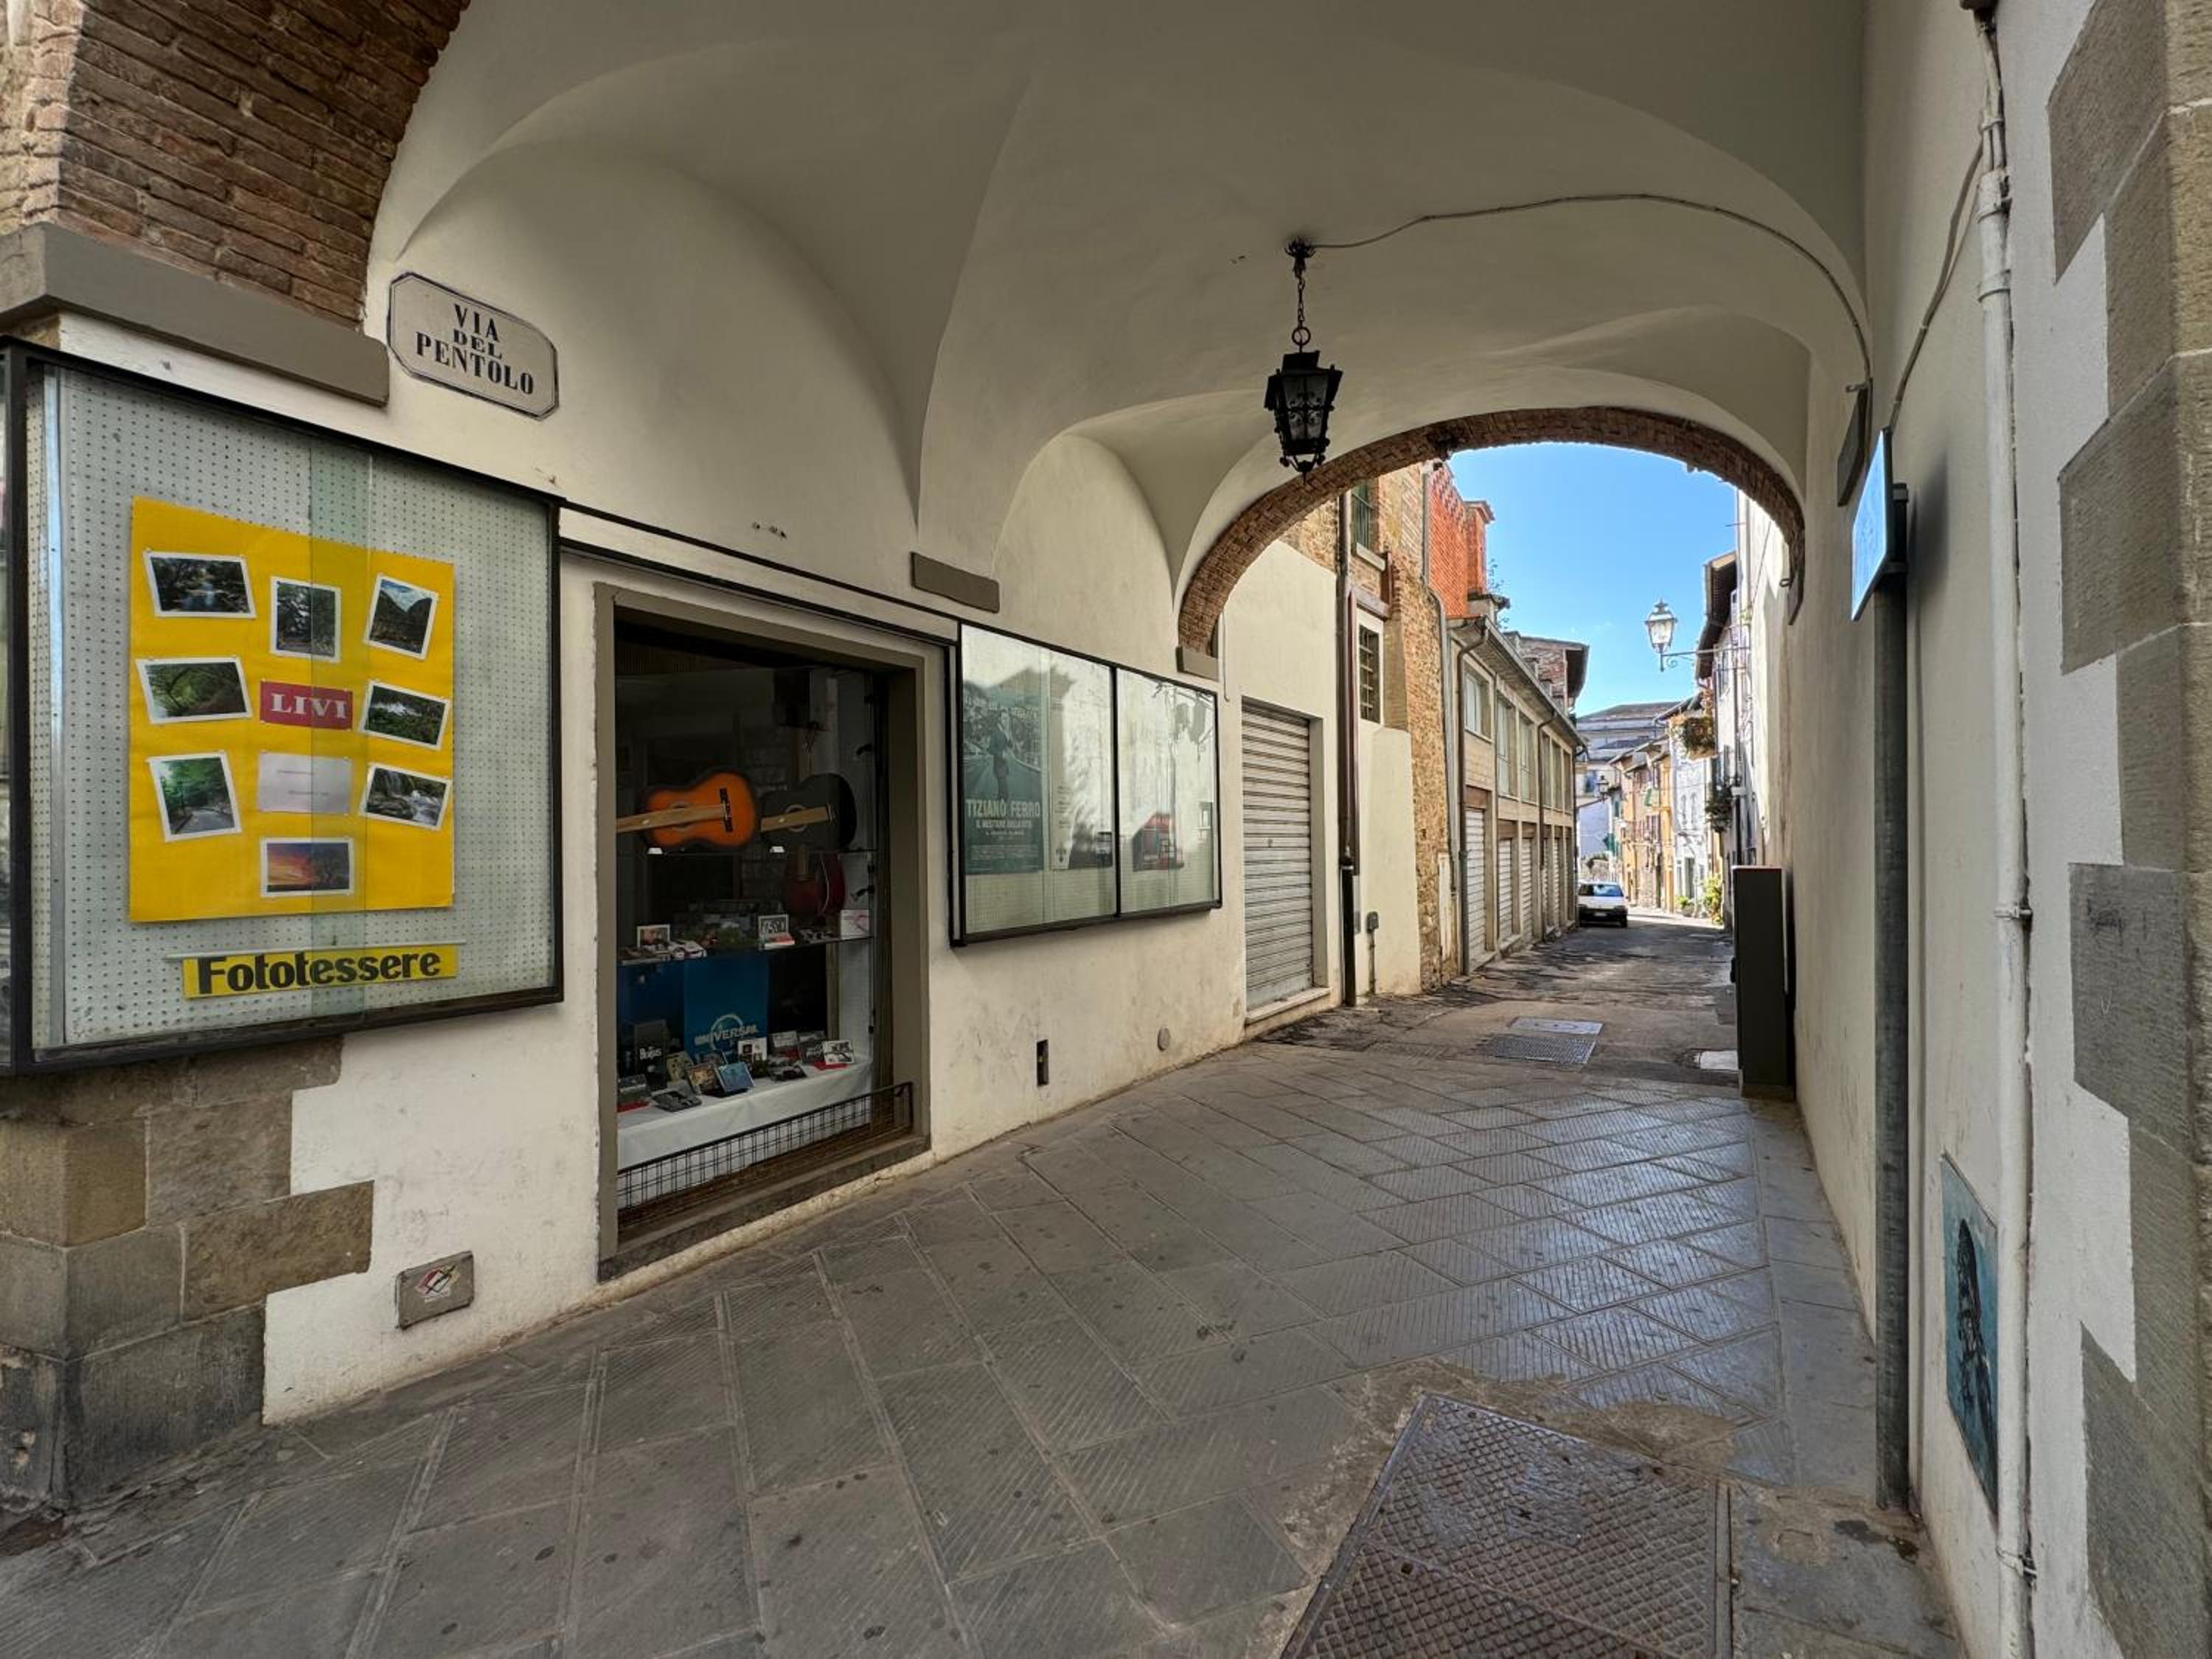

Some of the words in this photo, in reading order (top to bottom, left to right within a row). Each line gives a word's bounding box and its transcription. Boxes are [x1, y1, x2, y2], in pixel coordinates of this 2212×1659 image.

[453, 303, 500, 343] VIA
[453, 328, 503, 361] DEL
[415, 331, 534, 395] PENTOLO
[271, 692, 347, 719] LIVI
[965, 799, 1006, 818] TIZIANO
[1011, 800, 1041, 818] FERRO
[197, 951, 441, 995] Fototessere
[694, 1023, 759, 1046] VERSAL
